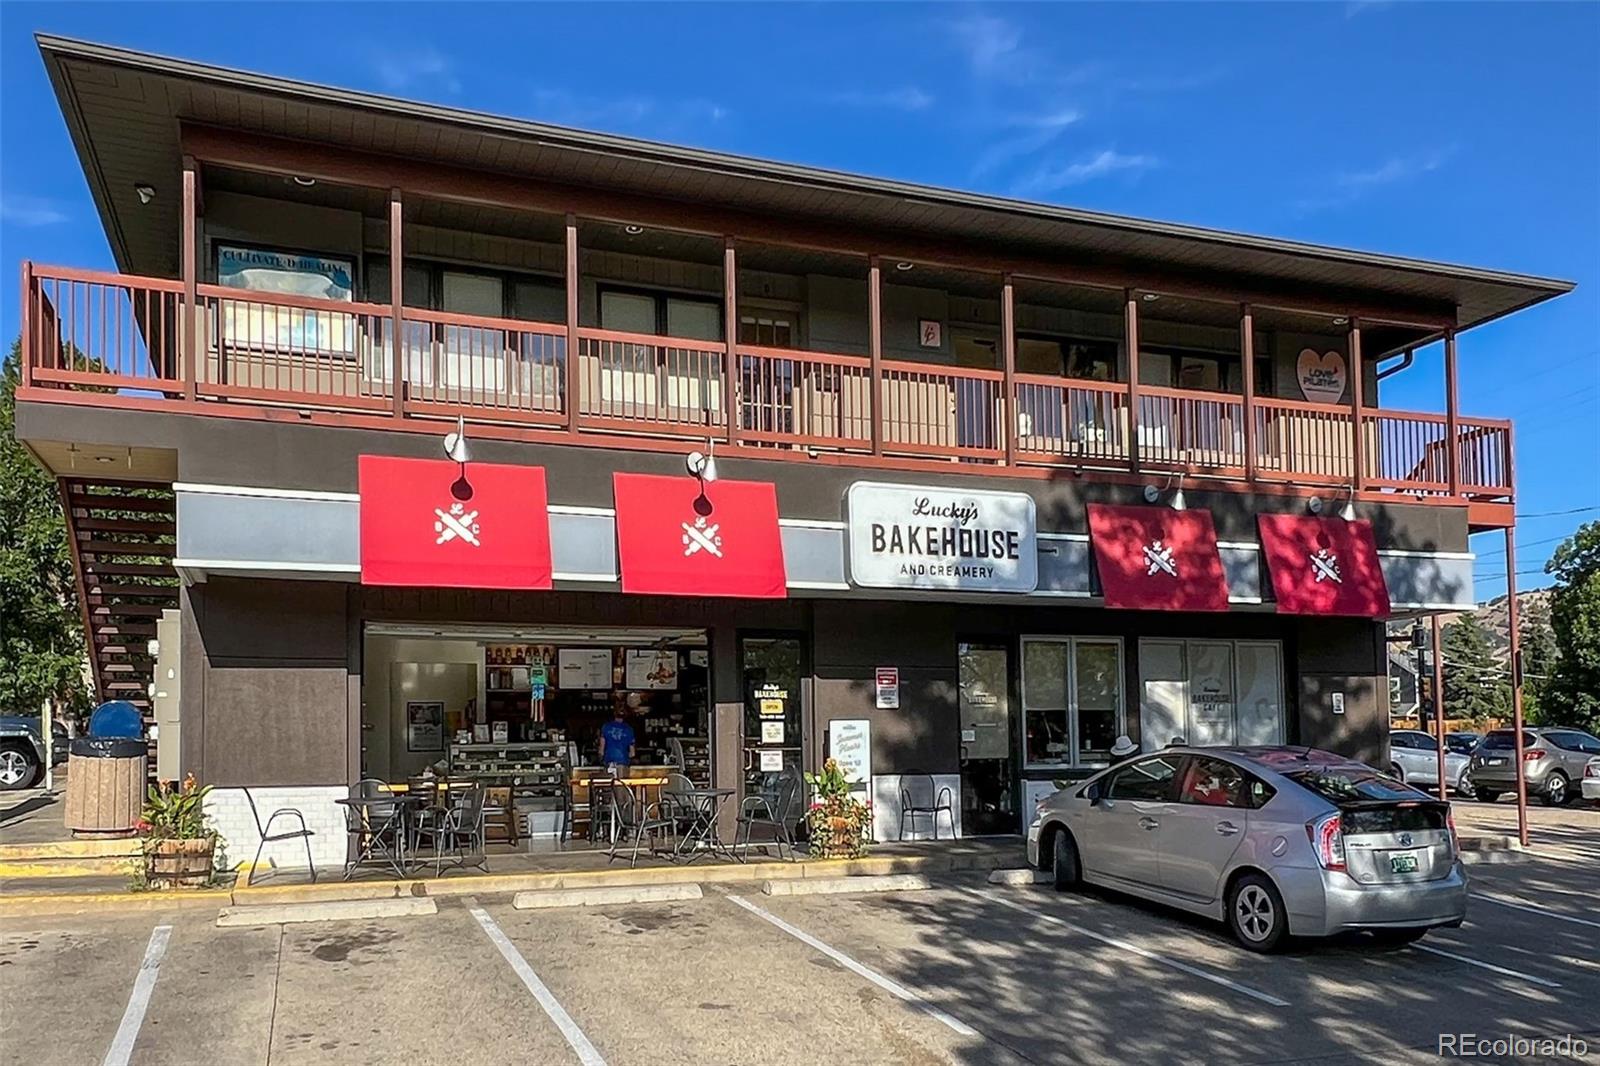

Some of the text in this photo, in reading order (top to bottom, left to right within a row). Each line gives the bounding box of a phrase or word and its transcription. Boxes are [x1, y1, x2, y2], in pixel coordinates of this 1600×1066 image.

[912, 497, 978, 526] Lucky's
[871, 523, 1019, 560] BAKEHOUSE
[900, 564, 994, 579] AND CREAMERY
